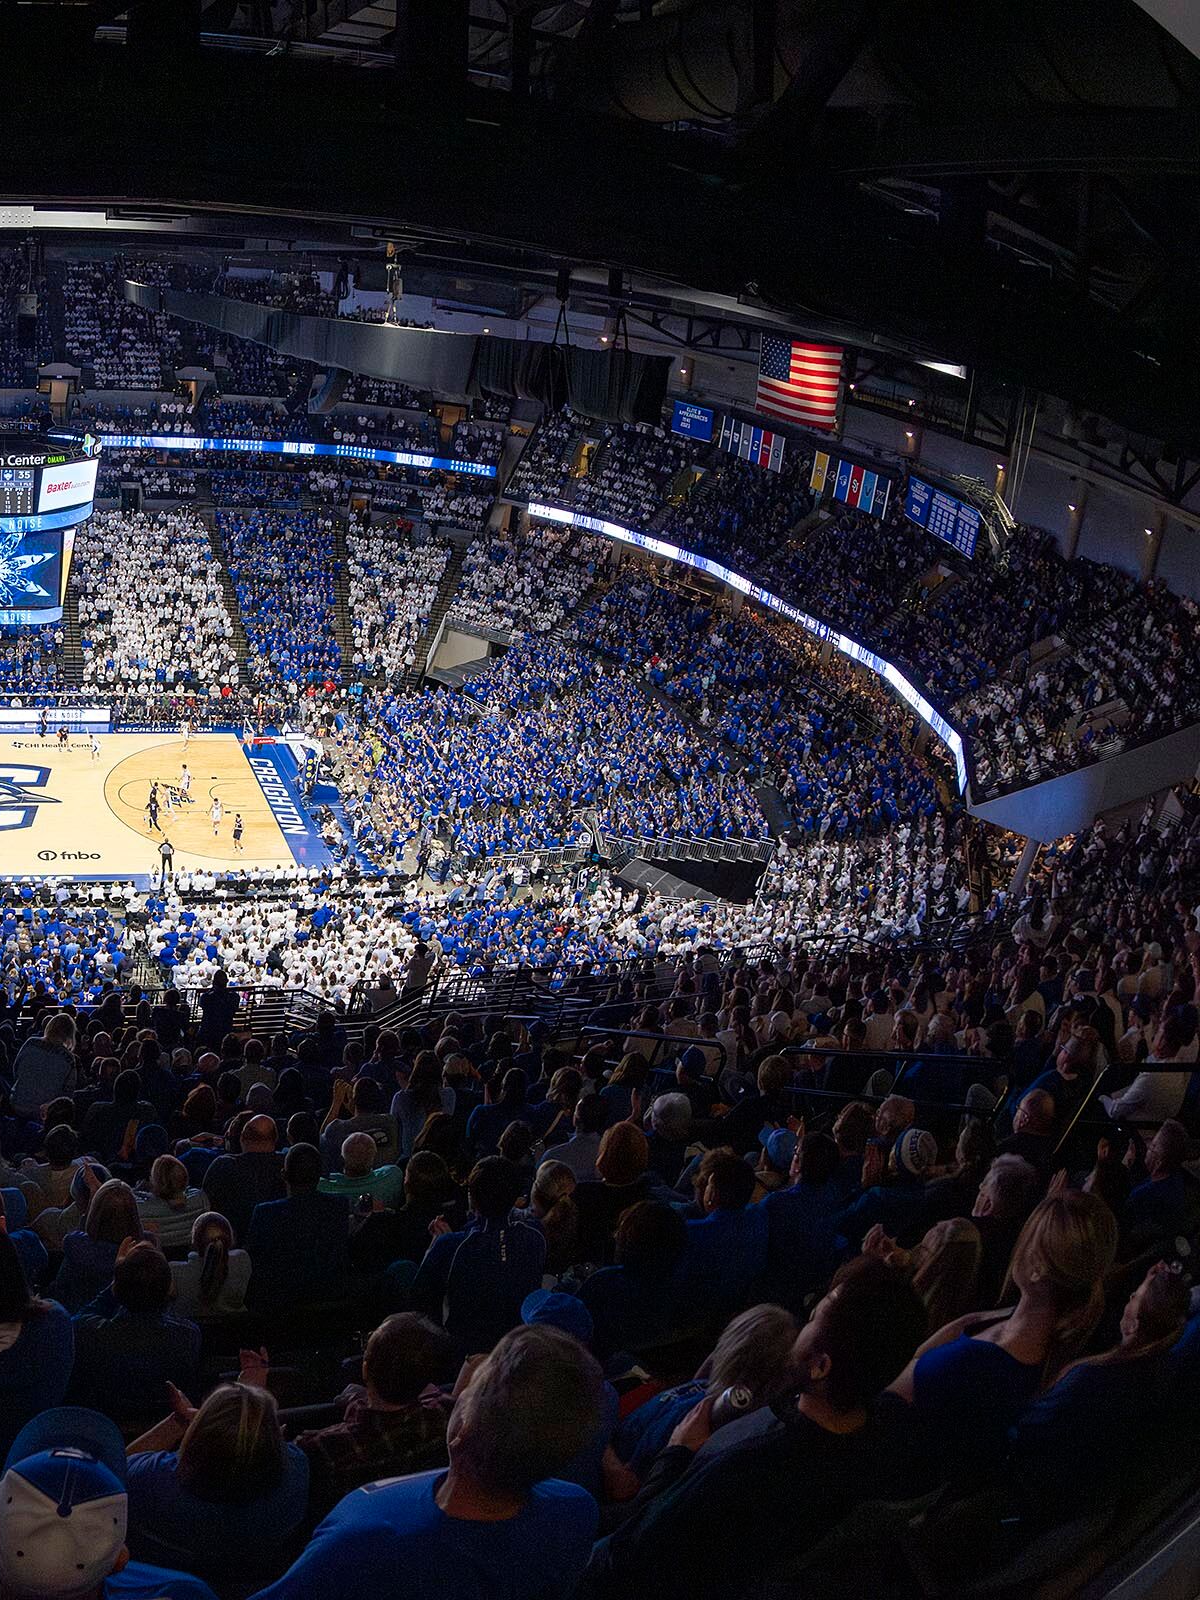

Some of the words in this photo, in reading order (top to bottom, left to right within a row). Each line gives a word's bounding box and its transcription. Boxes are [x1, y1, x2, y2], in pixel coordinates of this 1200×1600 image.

[7, 455, 47, 466] Center
[47, 455, 65, 464] OMAHA
[47, 481, 72, 494] Baxter
[8, 518, 43, 530] NOISE
[7, 613, 32, 621] NOISE
[249, 757, 309, 835] CREIGHTON
[61, 850, 101, 860] fnbo
